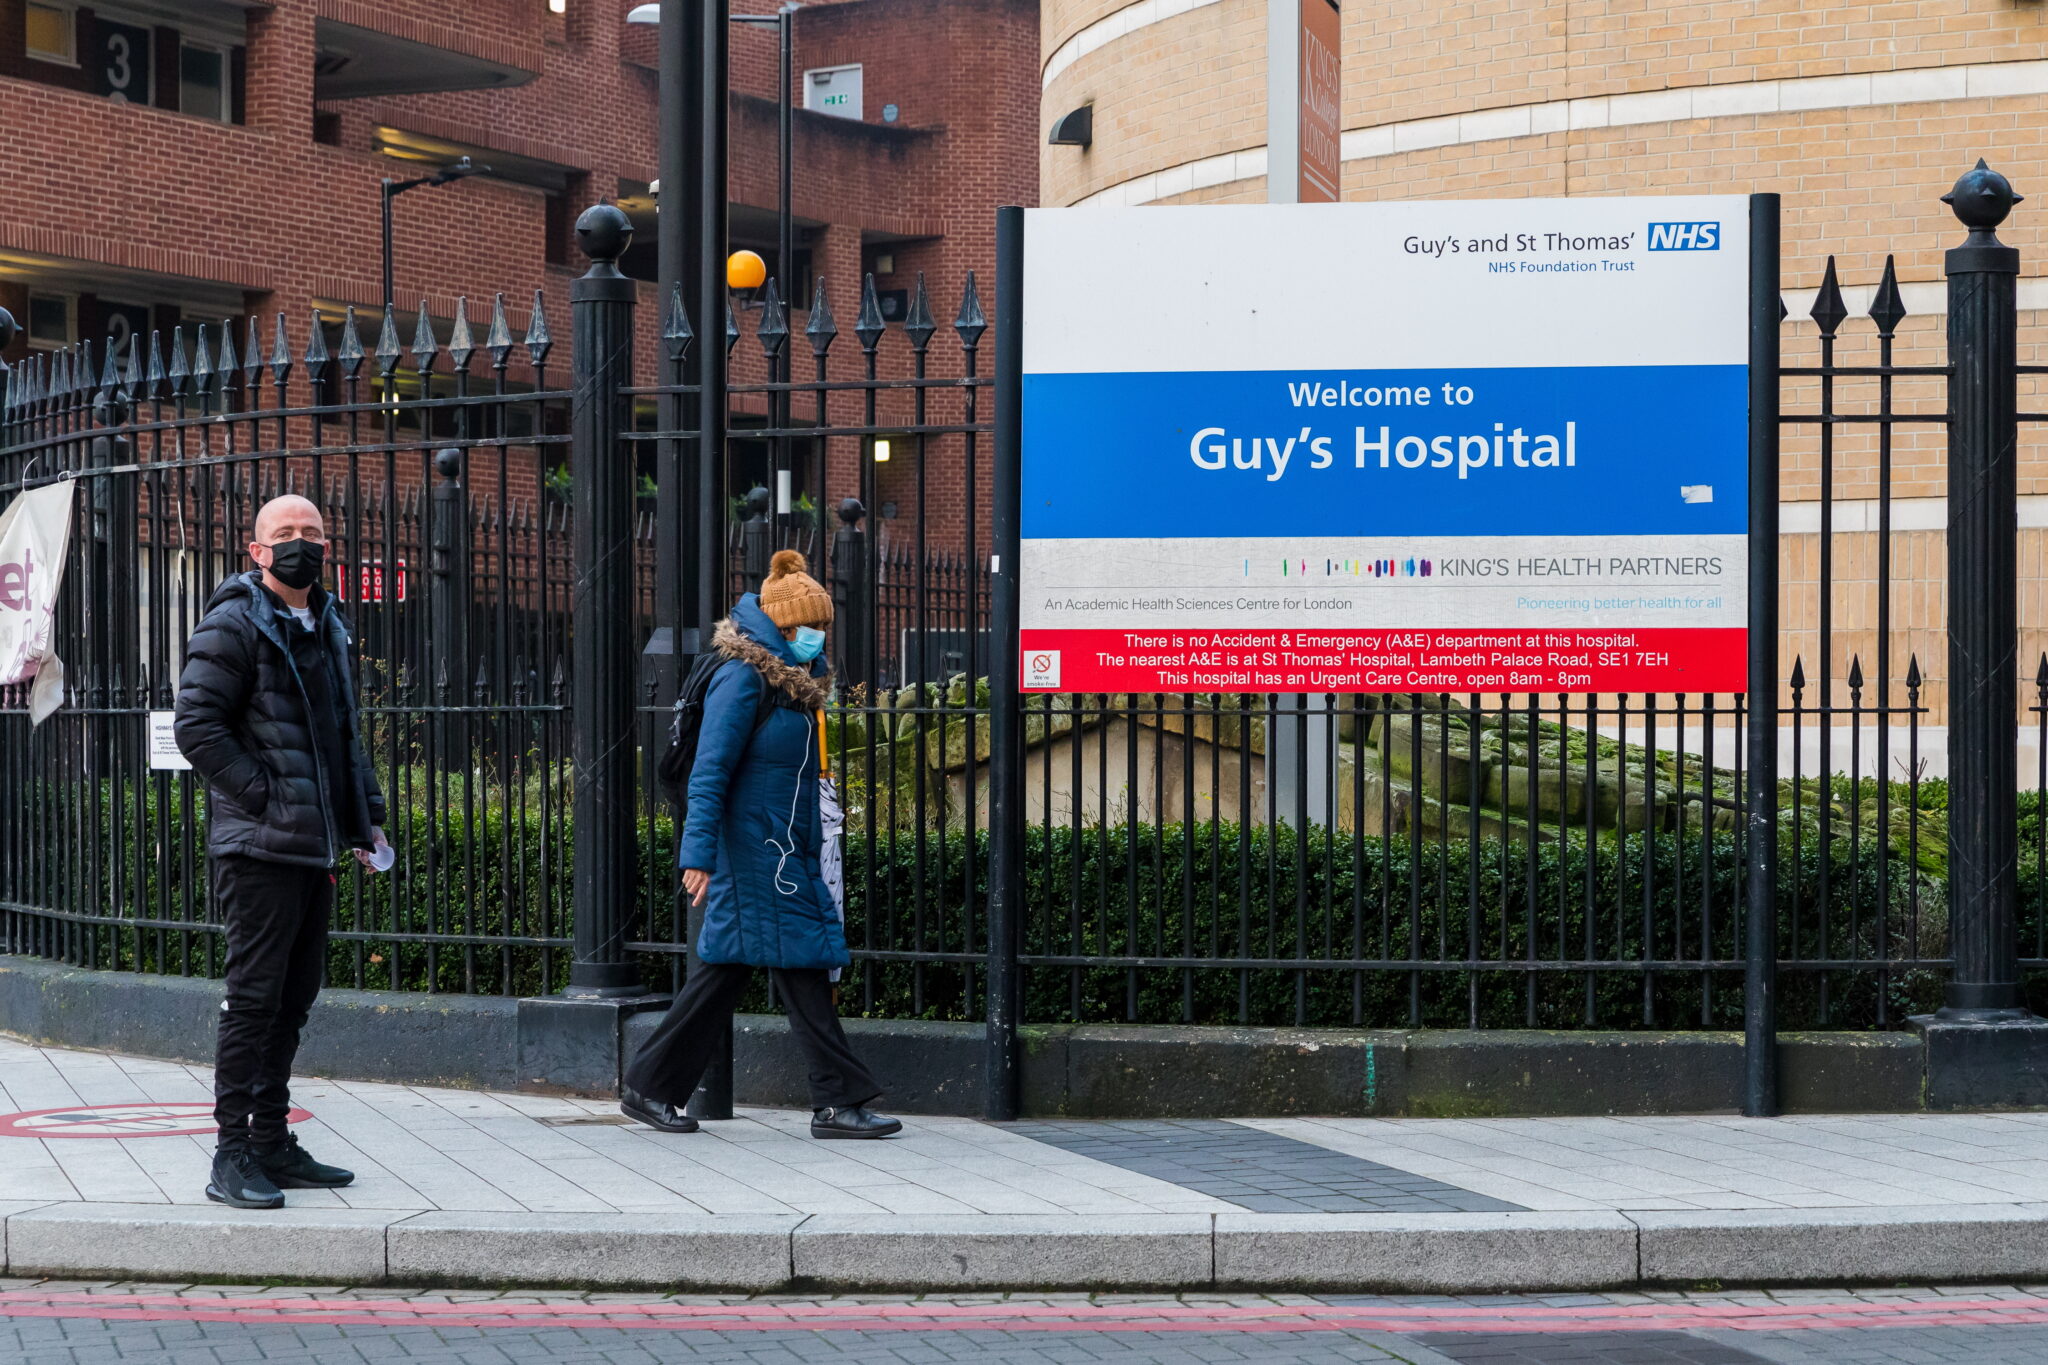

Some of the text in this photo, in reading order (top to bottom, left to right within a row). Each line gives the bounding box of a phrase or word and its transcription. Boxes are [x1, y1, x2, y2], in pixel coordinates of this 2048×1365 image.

[107, 34, 131, 90] 3
[1304, 27, 1338, 112] KING'S
[1315, 85, 1337, 135] College
[1304, 117, 1337, 176] LONDON
[1404, 232, 1634, 258] Guy's and St Thomas'
[1649, 223, 1718, 249] NHS
[1489, 261, 1634, 272] NHS Foundation Trust
[108, 313, 130, 367] 2
[1288, 381, 1473, 406] Welcome to
[1190, 422, 1575, 481] Guy's Hospital
[1441, 557, 1721, 576] KING'S HEALTH PARTNERS
[0, 548, 34, 612] et
[1045, 598, 1351, 609] An Academic Health Sciences Centre for London
[1518, 597, 1721, 611] Pioneering better health for all
[1124, 634, 1638, 650] There is no Accident & Emergency (A&E) department at this hospital.
[1096, 652, 1668, 669] The nearest A&E is at St Thomas' Hospital, Lambeth Palace Road, SE1 7EH
[1157, 671, 1188, 684] This
[1194, 671, 1250, 687] hospital
[1256, 671, 1282, 684] has
[1287, 674, 1305, 684] an
[1311, 672, 1361, 688] Urgent
[1366, 671, 1401, 685] Care
[1407, 671, 1461, 687] Centre,
[1467, 675, 1504, 688] open
[1510, 672, 1542, 685] 8am
[1558, 672, 1590, 688] 8pm
